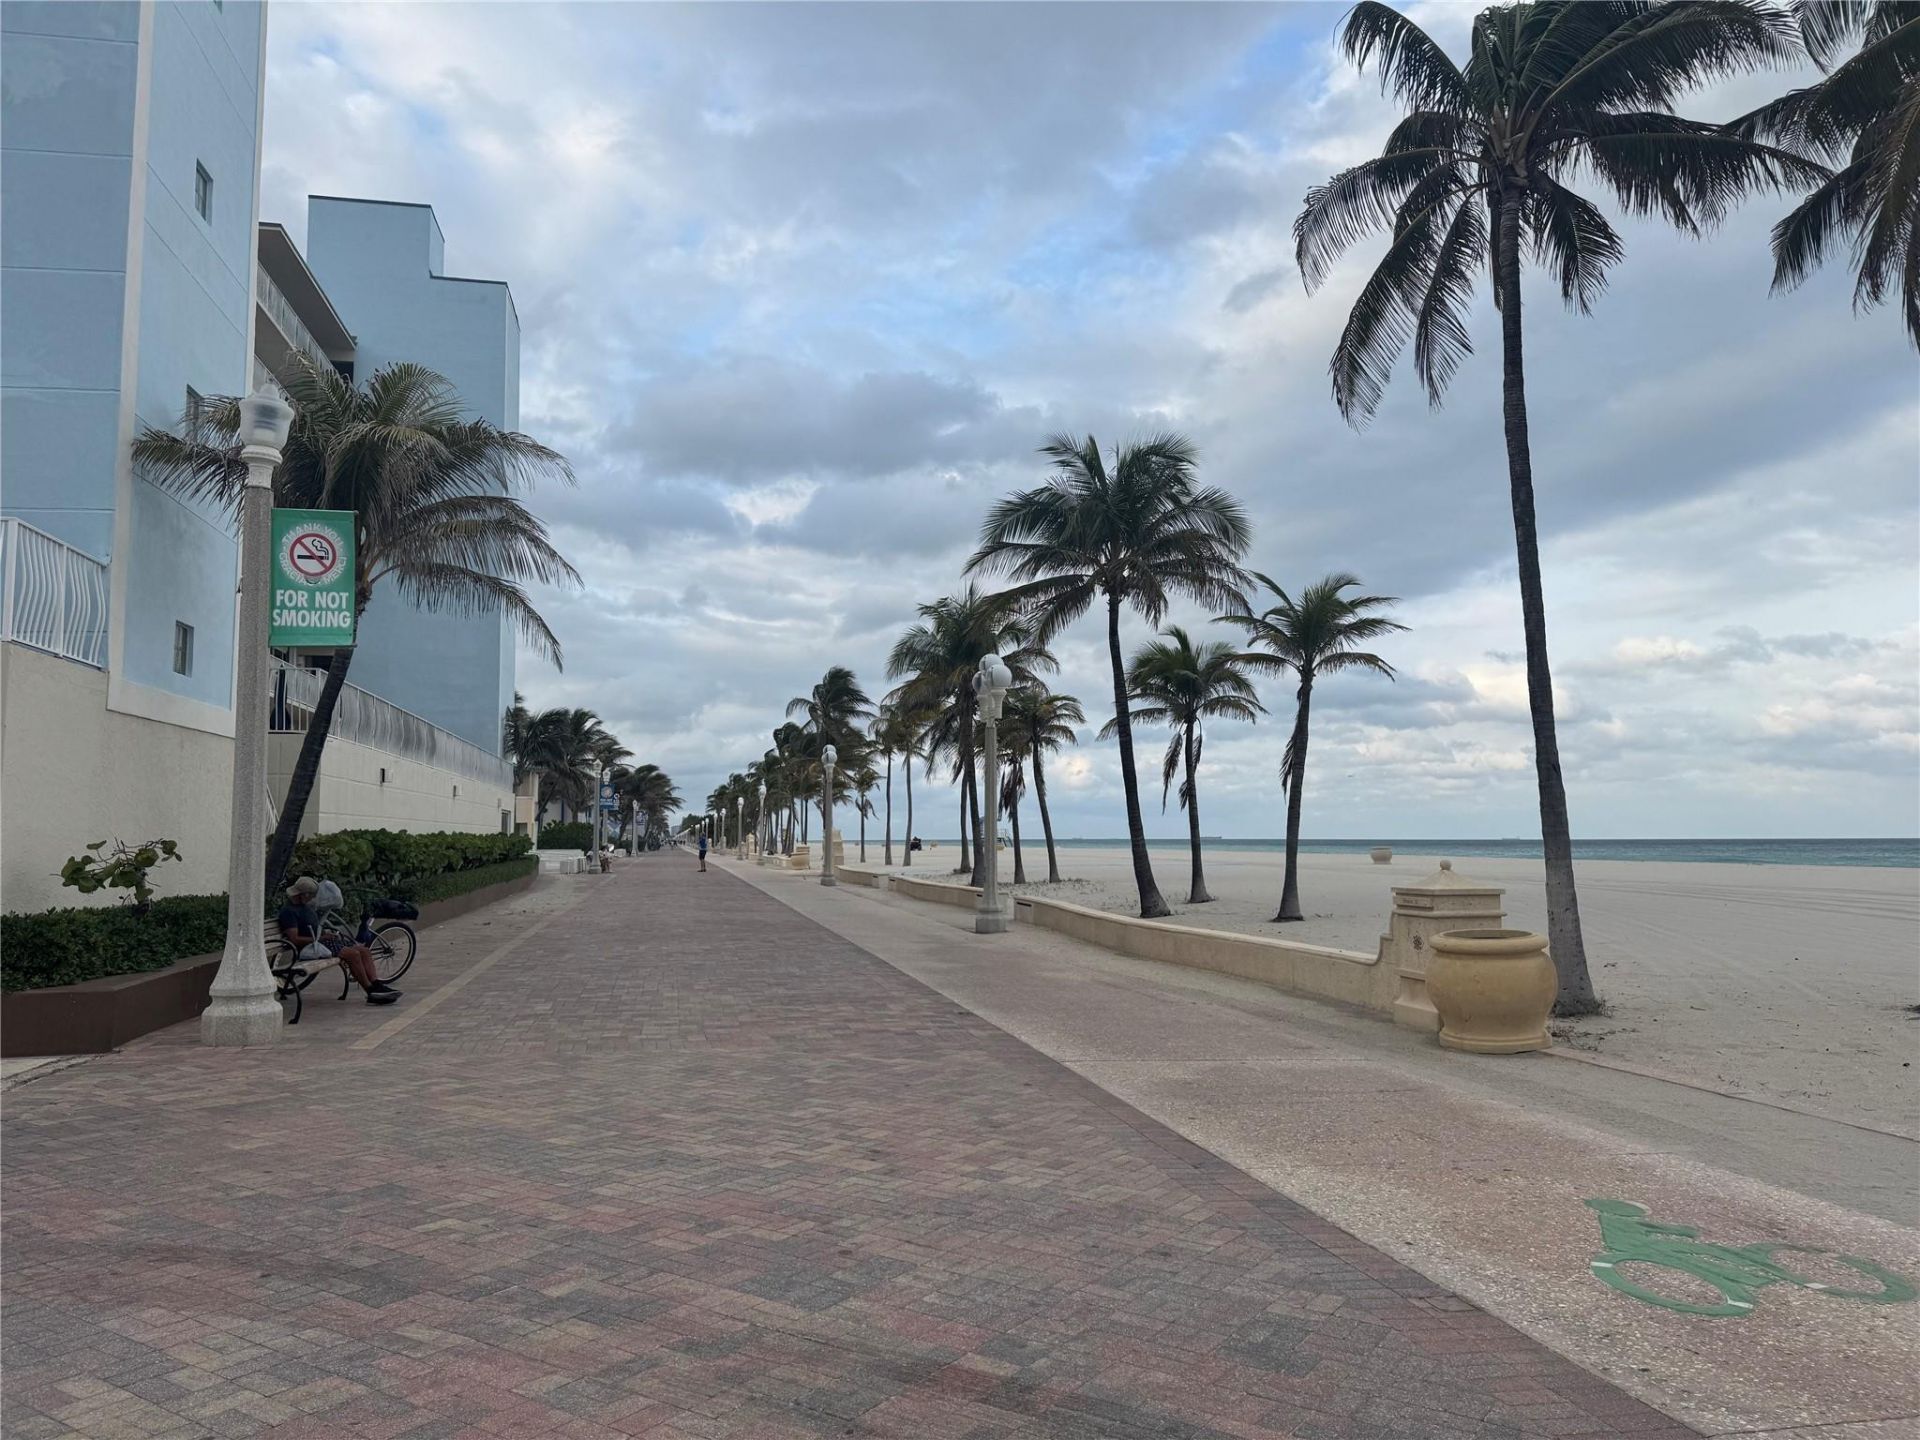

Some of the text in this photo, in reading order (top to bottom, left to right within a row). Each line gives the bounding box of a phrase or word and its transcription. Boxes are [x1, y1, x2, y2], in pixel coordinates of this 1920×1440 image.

[282, 522, 344, 548] THANK YOU
[279, 552, 308, 586] GRACIA
[322, 556, 347, 584] MERCI
[276, 589, 349, 609] FOR NOT
[272, 609, 351, 628] SMOKING
